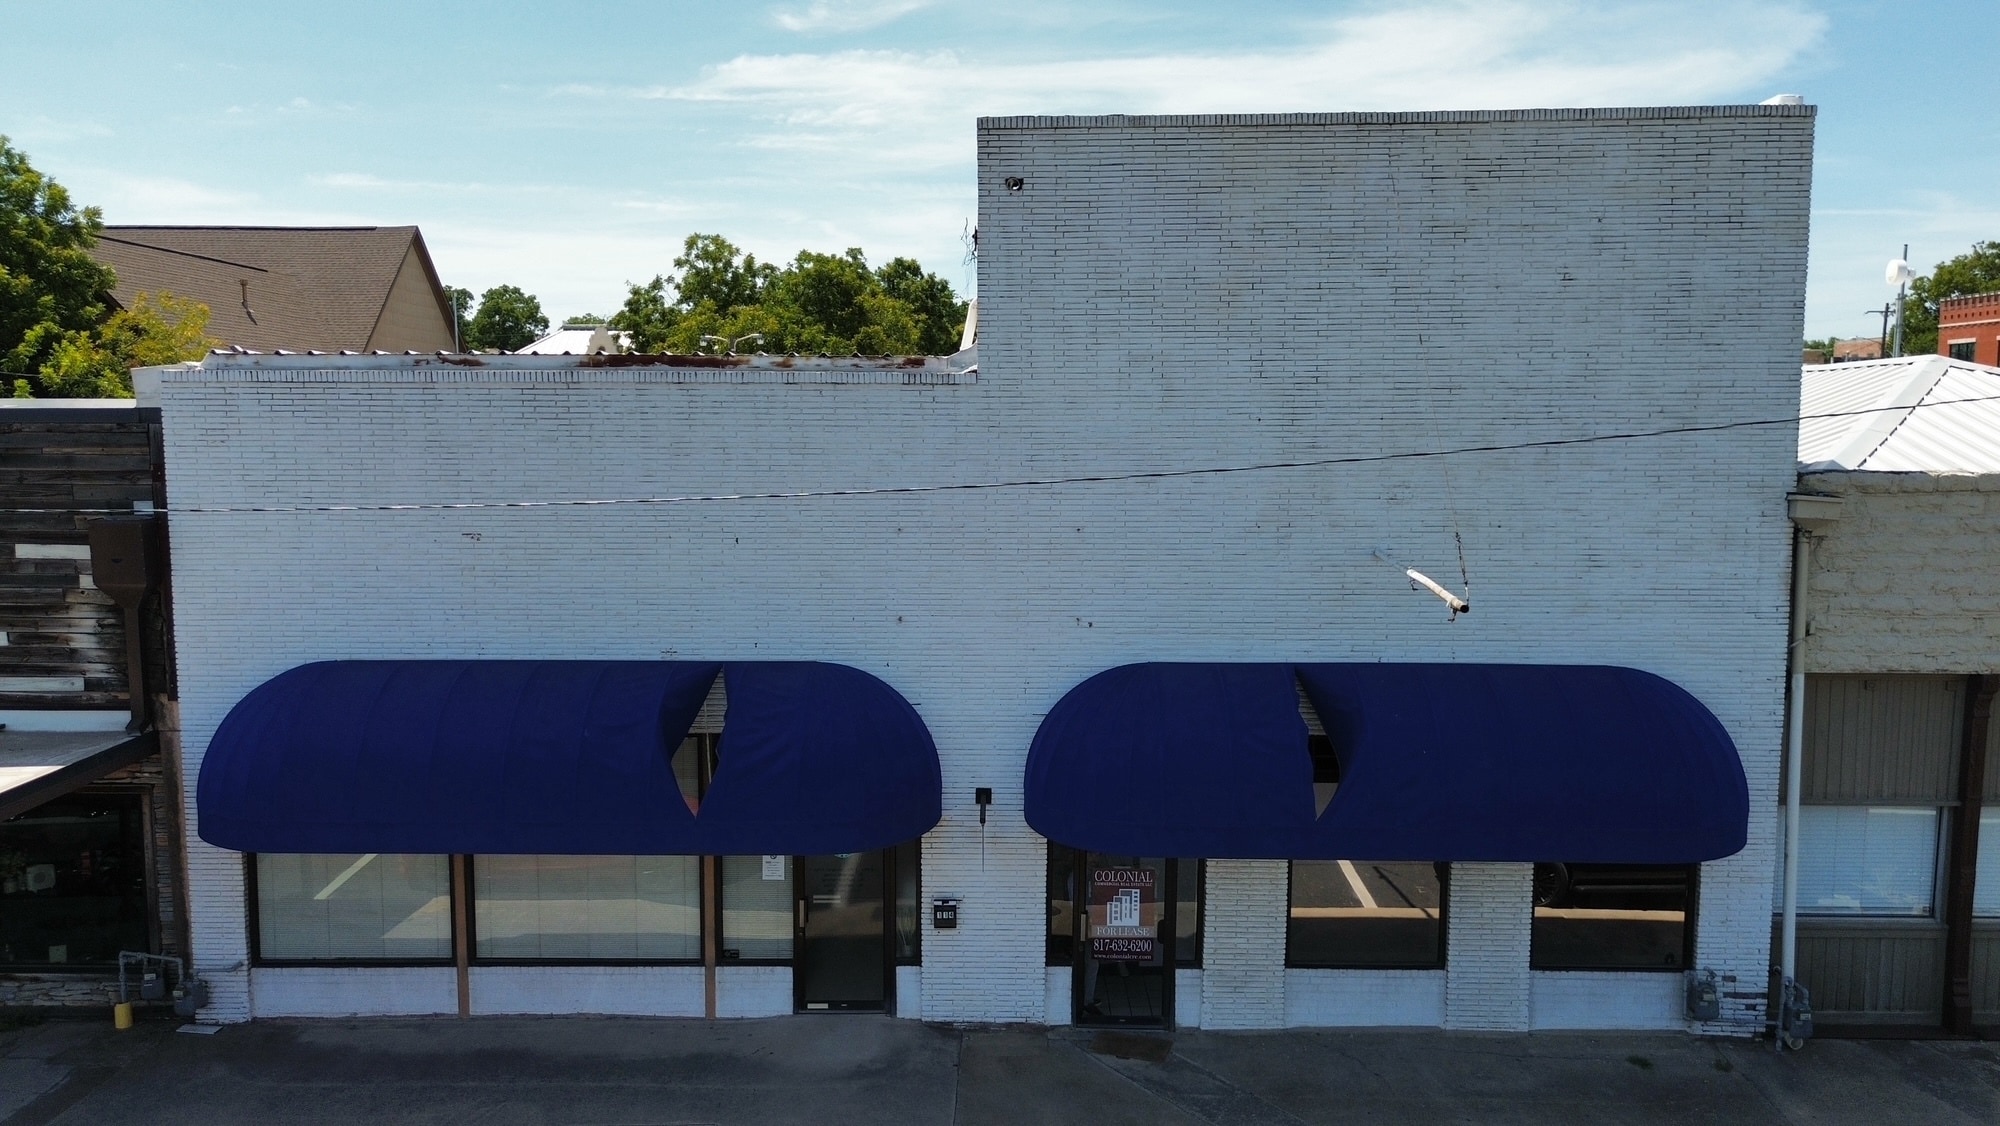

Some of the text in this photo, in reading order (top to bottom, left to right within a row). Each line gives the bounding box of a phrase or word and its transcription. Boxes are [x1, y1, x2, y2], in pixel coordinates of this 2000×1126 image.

[1094, 870, 1153, 882] COLONIAL
[1097, 926, 1150, 936] FOR LEASE
[1093, 938, 1152, 952] 817-632-6200
